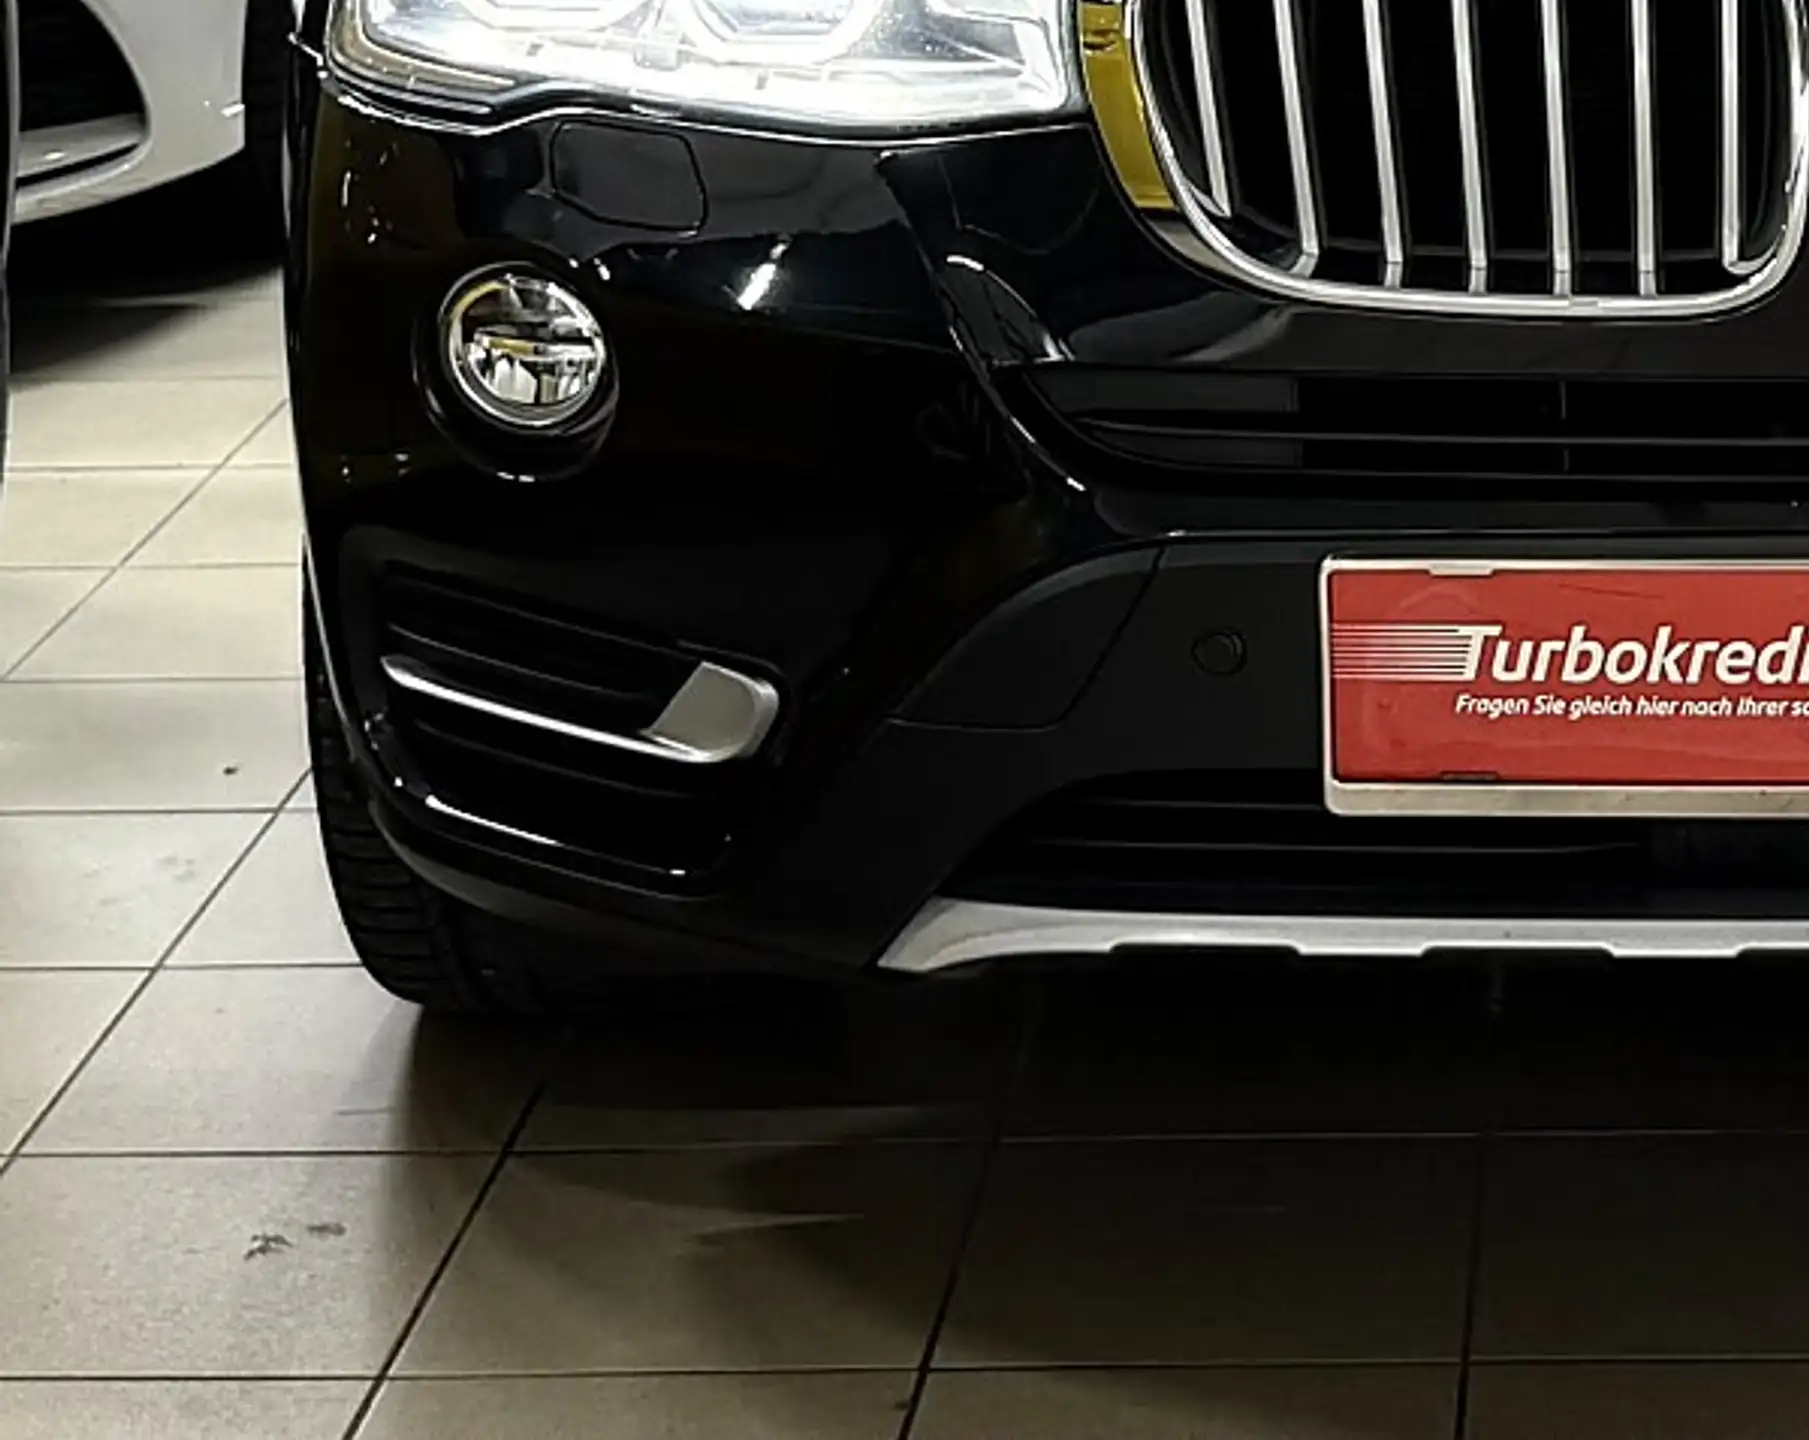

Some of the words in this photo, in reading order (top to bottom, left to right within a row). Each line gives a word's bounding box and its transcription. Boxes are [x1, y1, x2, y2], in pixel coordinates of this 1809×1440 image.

[1455, 693, 1530, 719] Fragen
[1532, 694, 1566, 715] Sie
[1568, 694, 1632, 720] gleich
[1636, 695, 1679, 715] hier
[1680, 696, 1732, 716] nach
[1736, 695, 1788, 716] Ihrer
